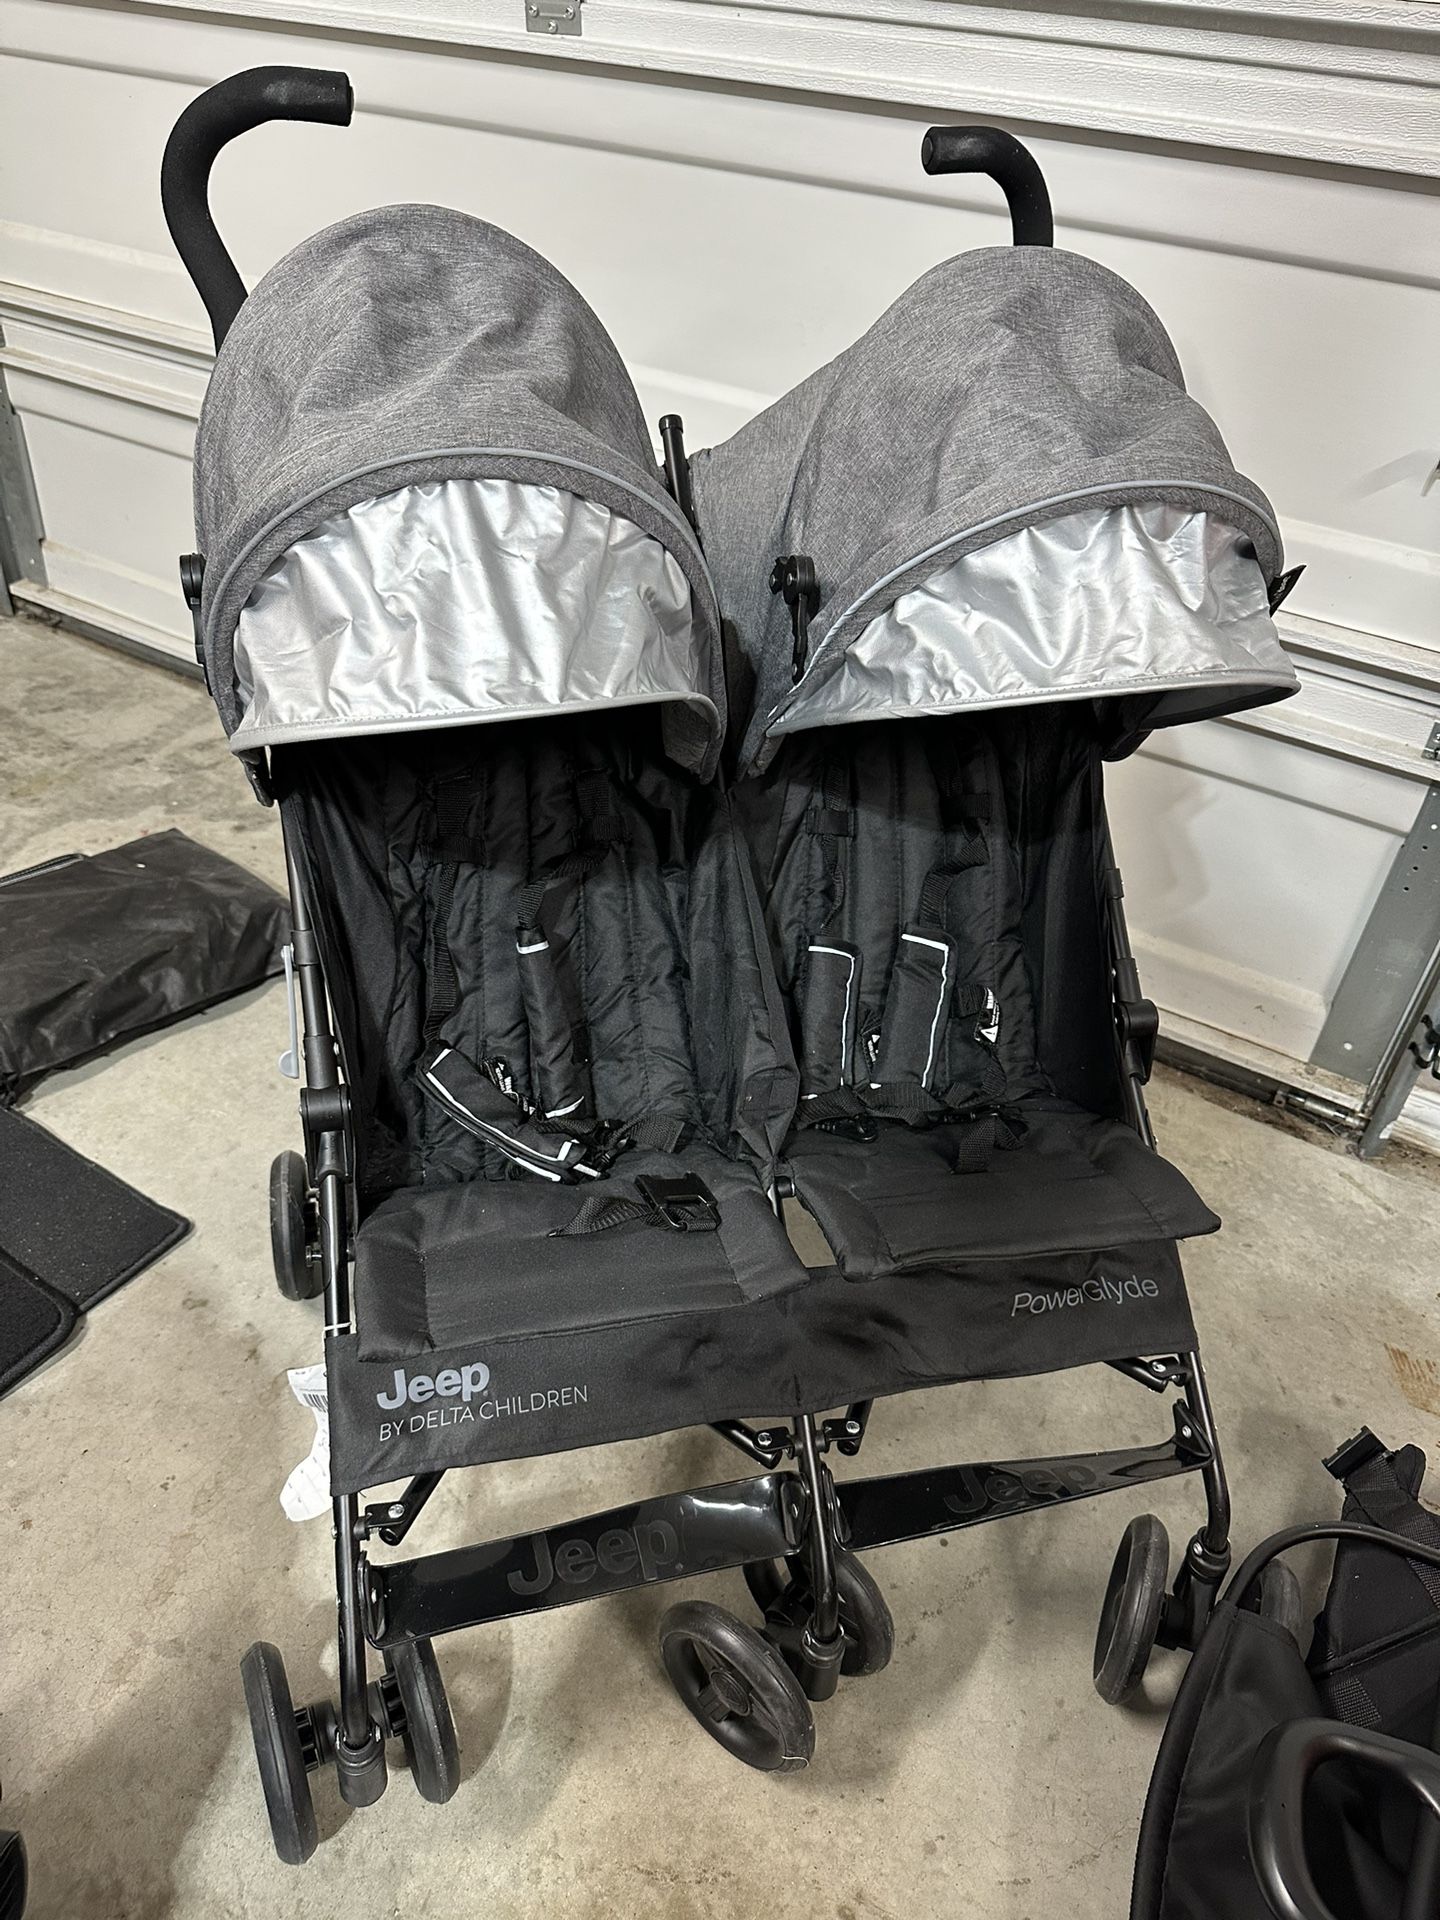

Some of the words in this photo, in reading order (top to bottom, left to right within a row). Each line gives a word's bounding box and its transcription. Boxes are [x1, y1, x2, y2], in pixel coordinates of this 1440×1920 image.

[1010, 1274, 1160, 1317] PowerGlyde
[376, 1361, 490, 1410] Jeep
[379, 1419, 405, 1442] BY
[409, 1404, 475, 1433] DELTA
[478, 1384, 589, 1420] CHILDREN
[945, 1464, 1097, 1514] Jeep
[506, 1519, 680, 1595] Jeep
